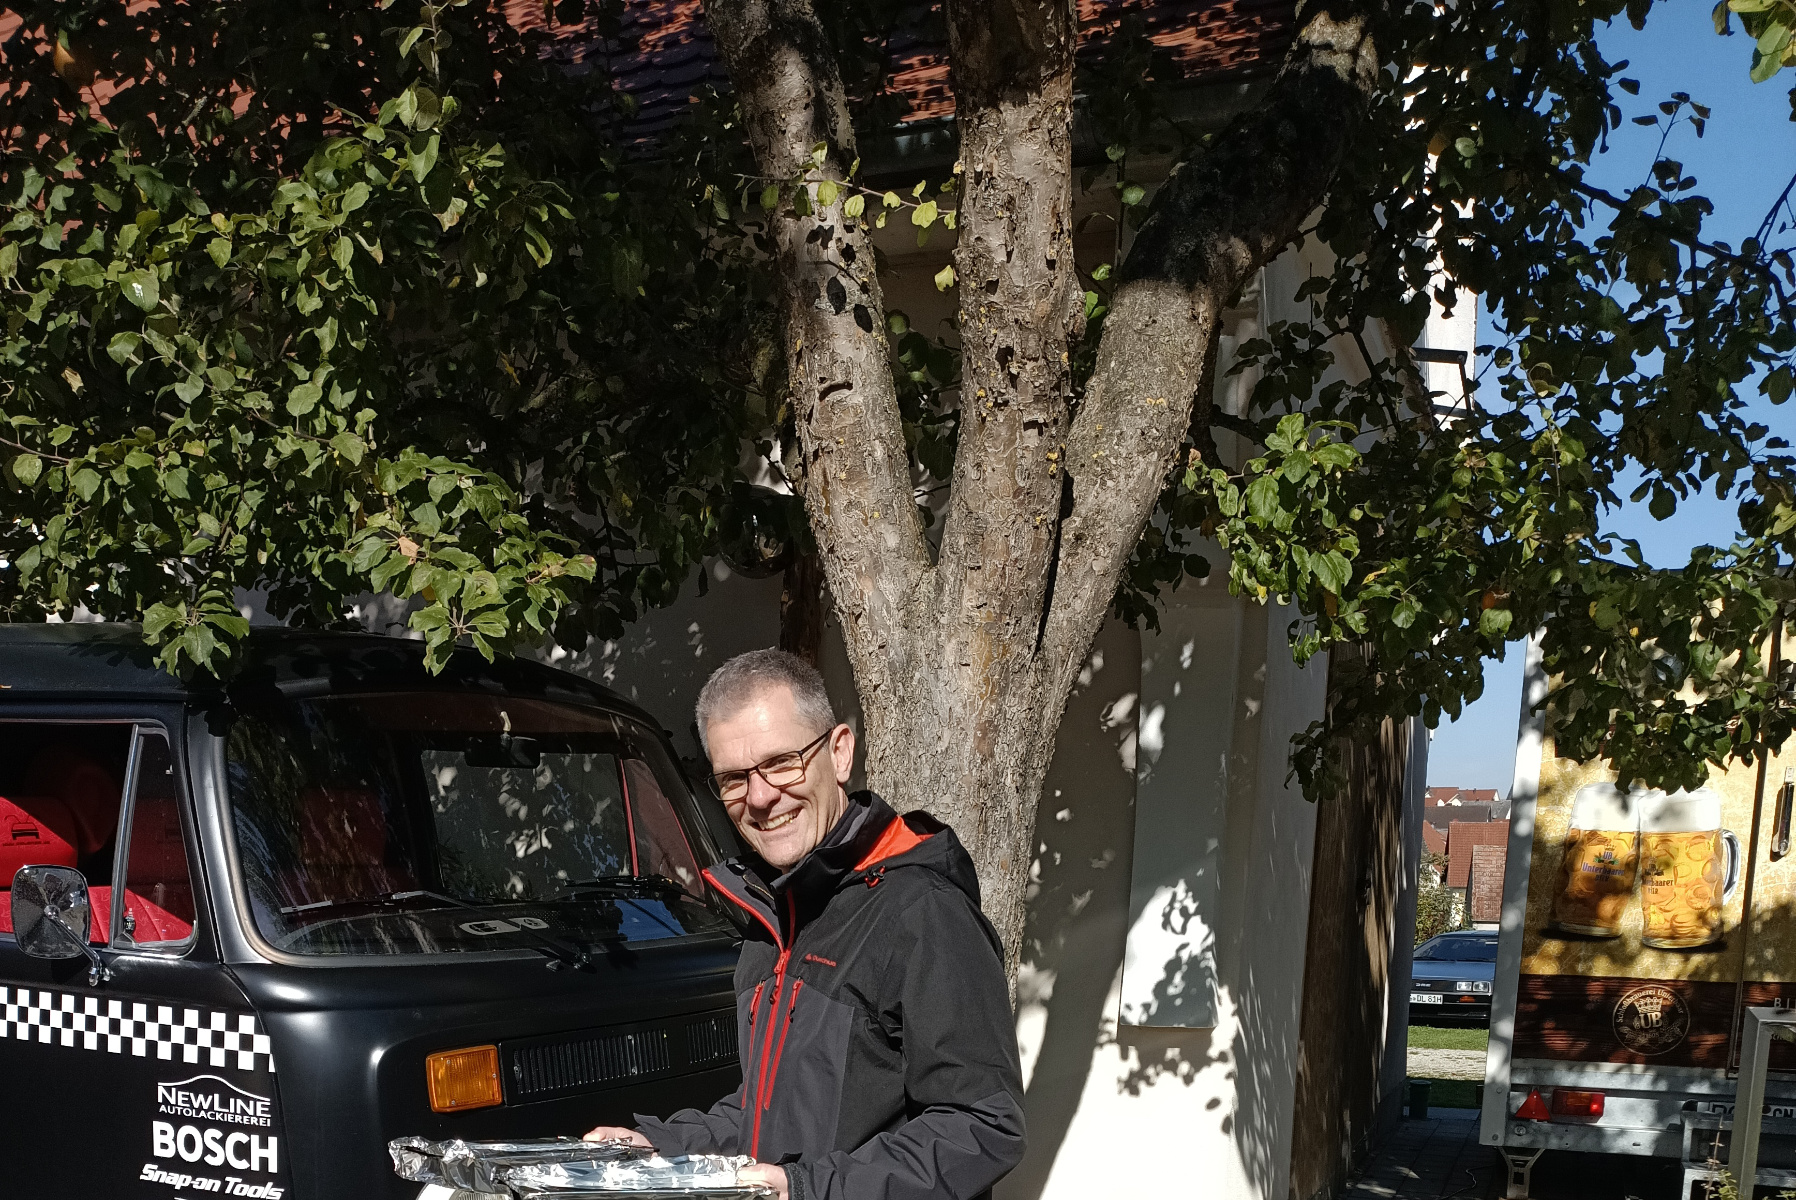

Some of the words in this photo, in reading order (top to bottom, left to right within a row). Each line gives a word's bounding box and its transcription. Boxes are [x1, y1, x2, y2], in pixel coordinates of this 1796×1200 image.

[1639, 1011, 1663, 1029] UB
[158, 1104, 271, 1127] AUTOLACKIEREREI
[152, 1120, 278, 1174] BOSCH
[139, 1163, 222, 1193] Snap-on
[224, 1176, 285, 1200] Tools
